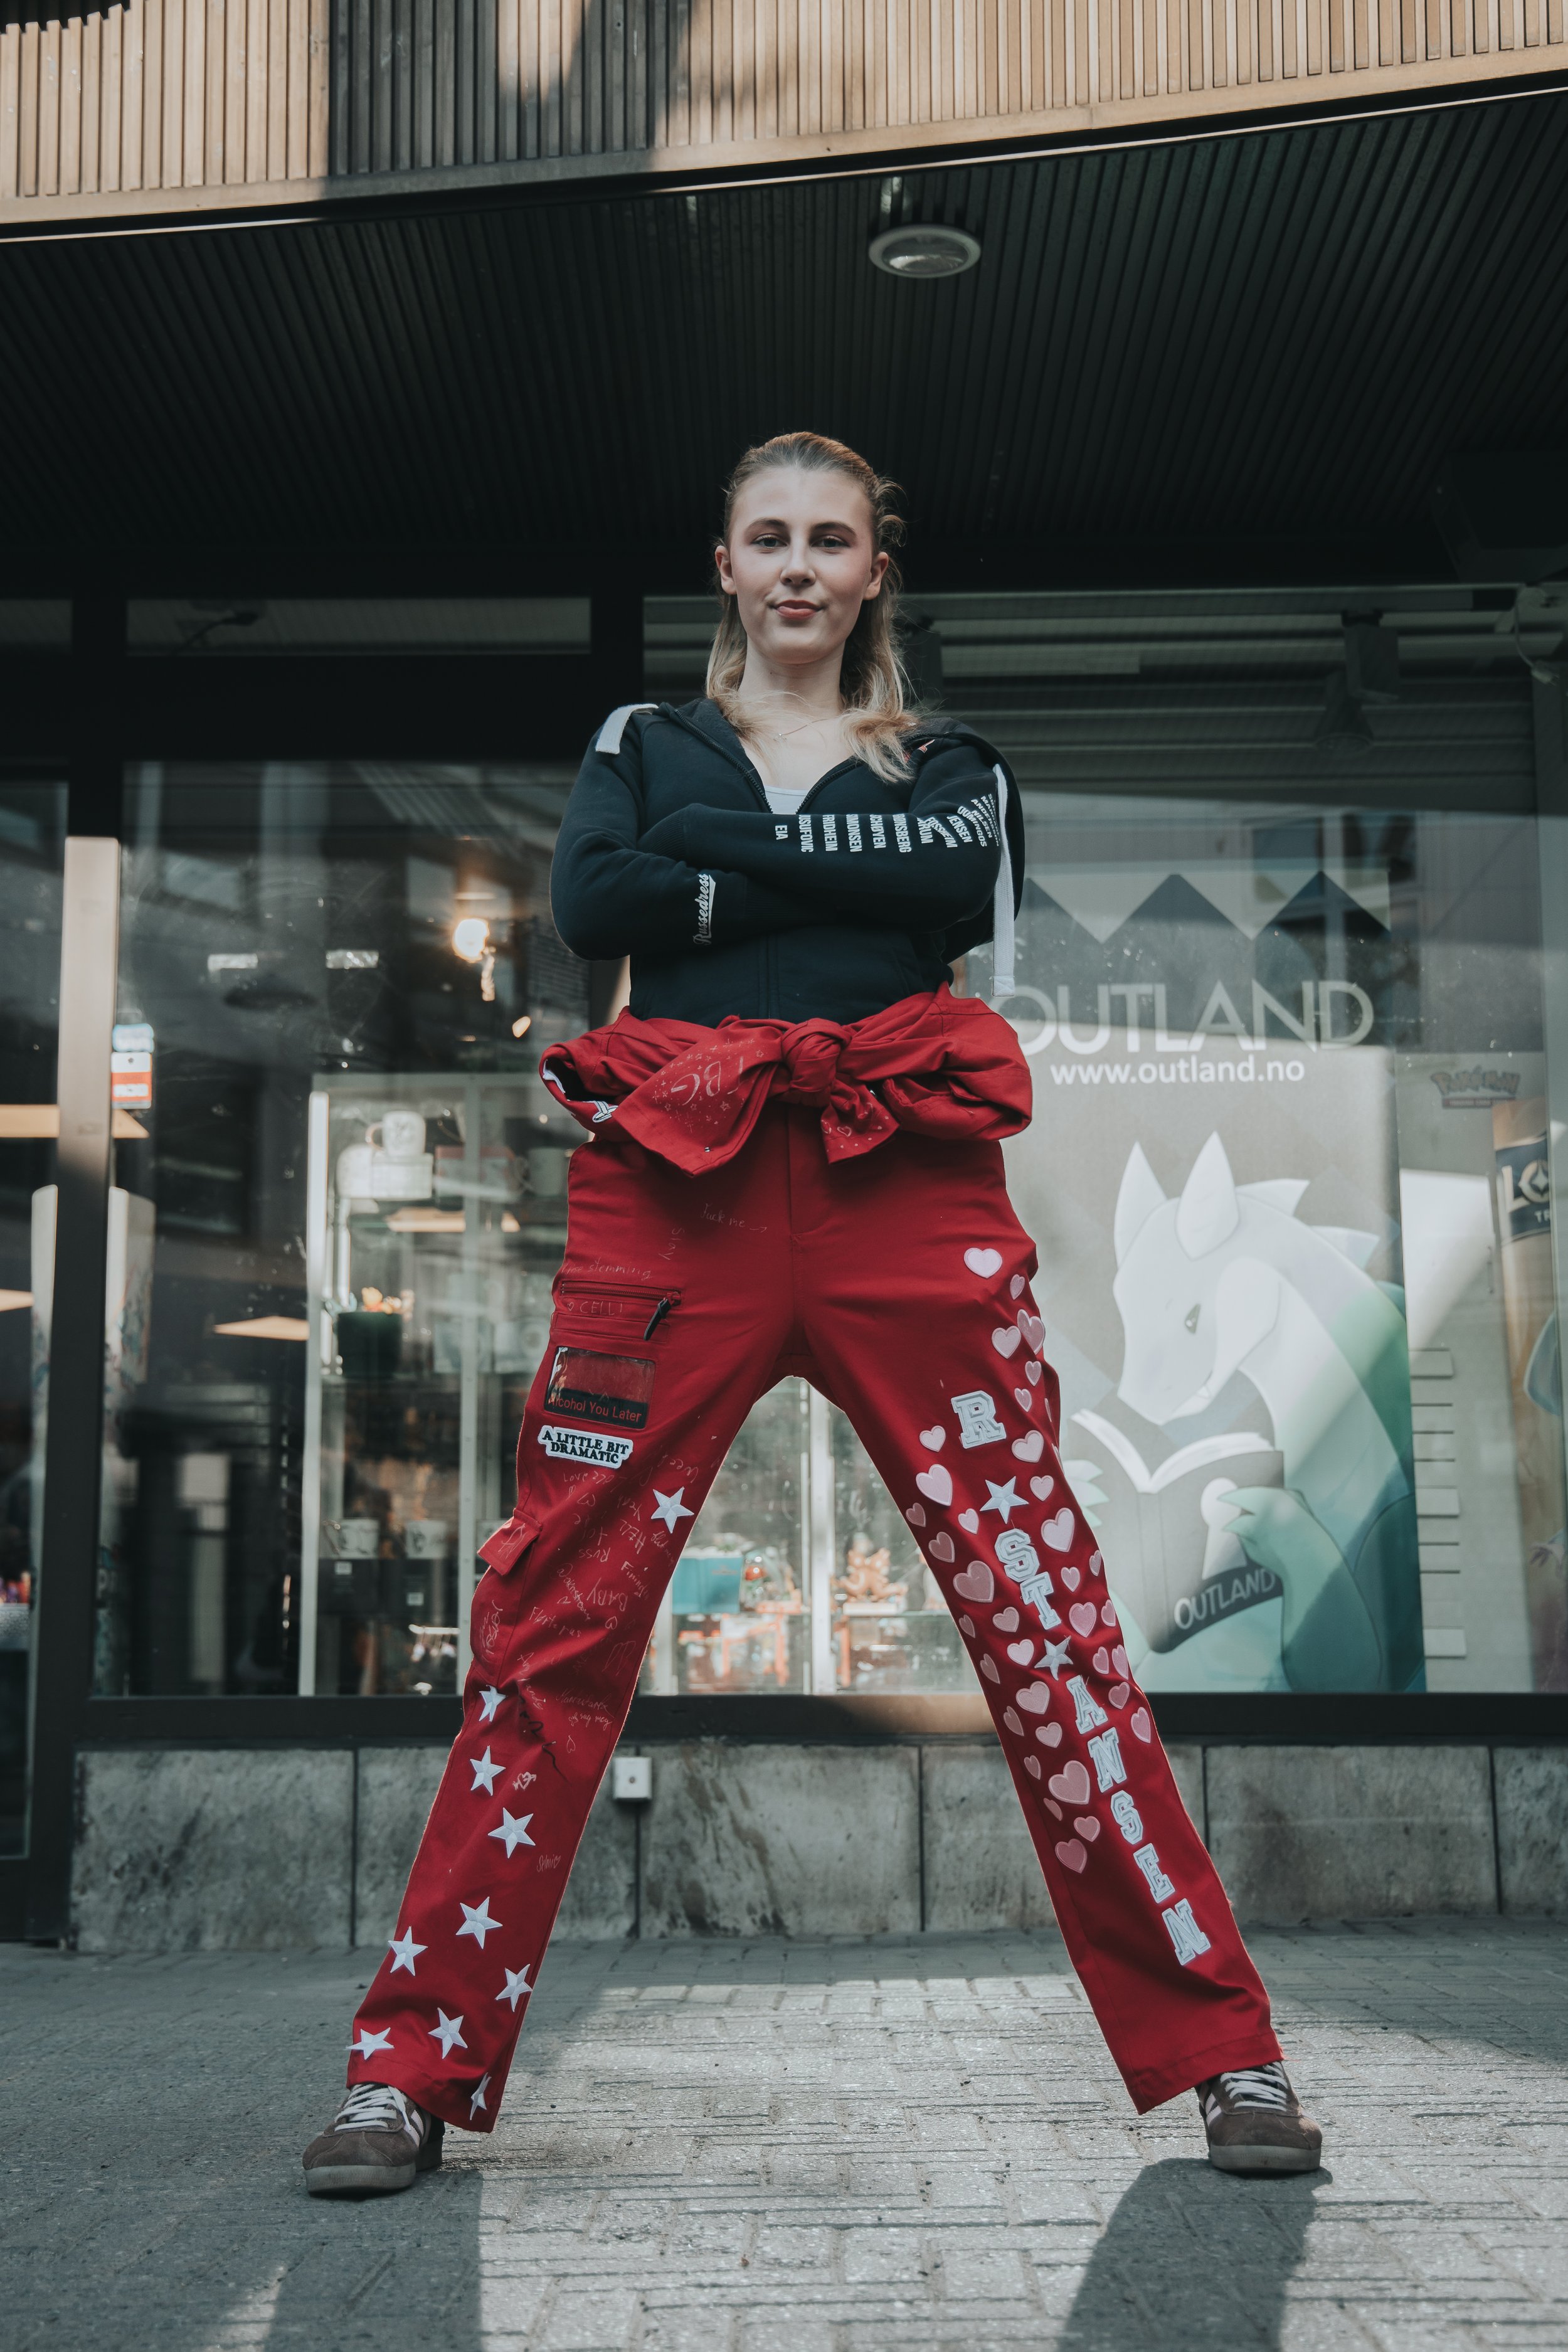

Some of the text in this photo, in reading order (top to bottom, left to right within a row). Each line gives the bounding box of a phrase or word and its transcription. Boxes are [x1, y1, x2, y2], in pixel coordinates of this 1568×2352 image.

[775, 825, 788, 840] EIA
[822, 814, 838, 852] FRIDHEIM
[845, 813, 862, 852] SIMONSEN
[946, 815, 973, 844] JENSEN
[956, 805, 987, 847] DOMINGOS
[970, 798, 999, 847] ANDERSSON
[971, 810, 993, 839] NILSEN
[692, 874, 712, 946] Russedress
[988, 978, 1374, 1056] OUTLAND
[1050, 1054, 1305, 1085] www.outland.no
[548, 1396, 642, 1422] Alcohol You Later
[951, 1390, 1007, 1449] R
[542, 1429, 629, 1455] A LITTLE BIT
[550, 1441, 619, 1464] DRAMATIC
[1173, 1568, 1277, 1631] OUTLAND
